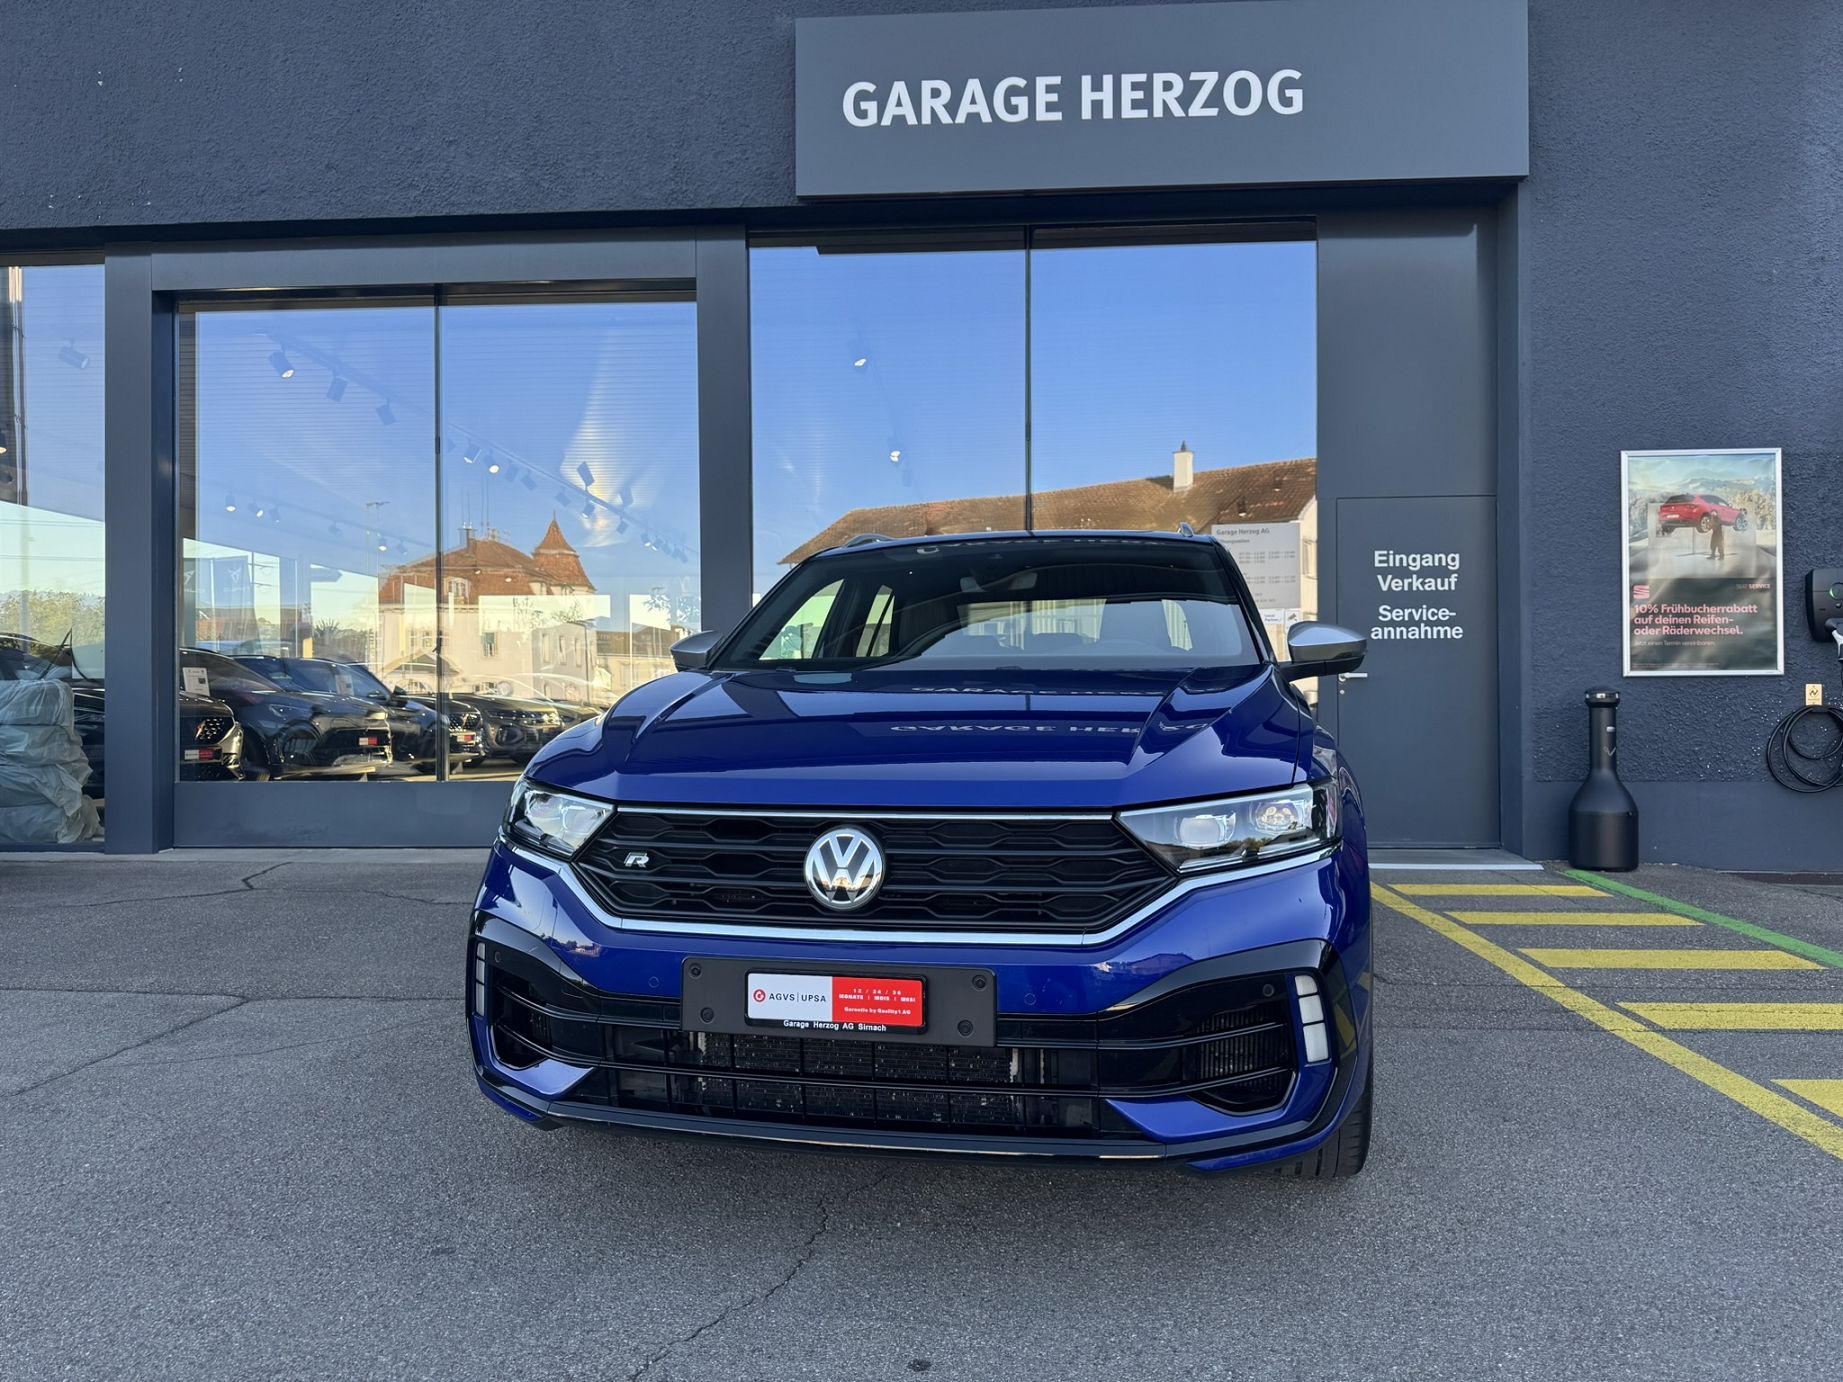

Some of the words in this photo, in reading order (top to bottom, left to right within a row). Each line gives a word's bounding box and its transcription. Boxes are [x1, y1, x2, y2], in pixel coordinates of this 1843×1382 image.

[842, 75, 1063, 127] GARAGE
[1081, 69, 1304, 120] HERZOG
[1216, 528, 1240, 536] Garage
[1239, 528, 1260, 536] Herzog
[1374, 550, 1460, 571] Eingang
[1376, 573, 1459, 591] Verkauf
[1378, 604, 1457, 621] Service-
[1634, 603, 1659, 614] 10%
[1661, 603, 1758, 614] Frühbucherrabatt
[1634, 614, 1655, 625] auf
[1655, 614, 1691, 625] deinen
[1693, 614, 1734, 625] Reifen-
[1370, 622, 1464, 639] annahme
[1634, 625, 1660, 636] oder
[1662, 624, 1744, 635] Räderwechsel.
[623, 851, 649, 868] R
[769, 992, 795, 1002] AGVS
[801, 994, 827, 1003] UPSA
[783, 1019, 810, 1029] Garage
[813, 1021, 839, 1031] Herzog
[842, 1022, 855, 1030] AG
[858, 1023, 887, 1032] Sirnach
